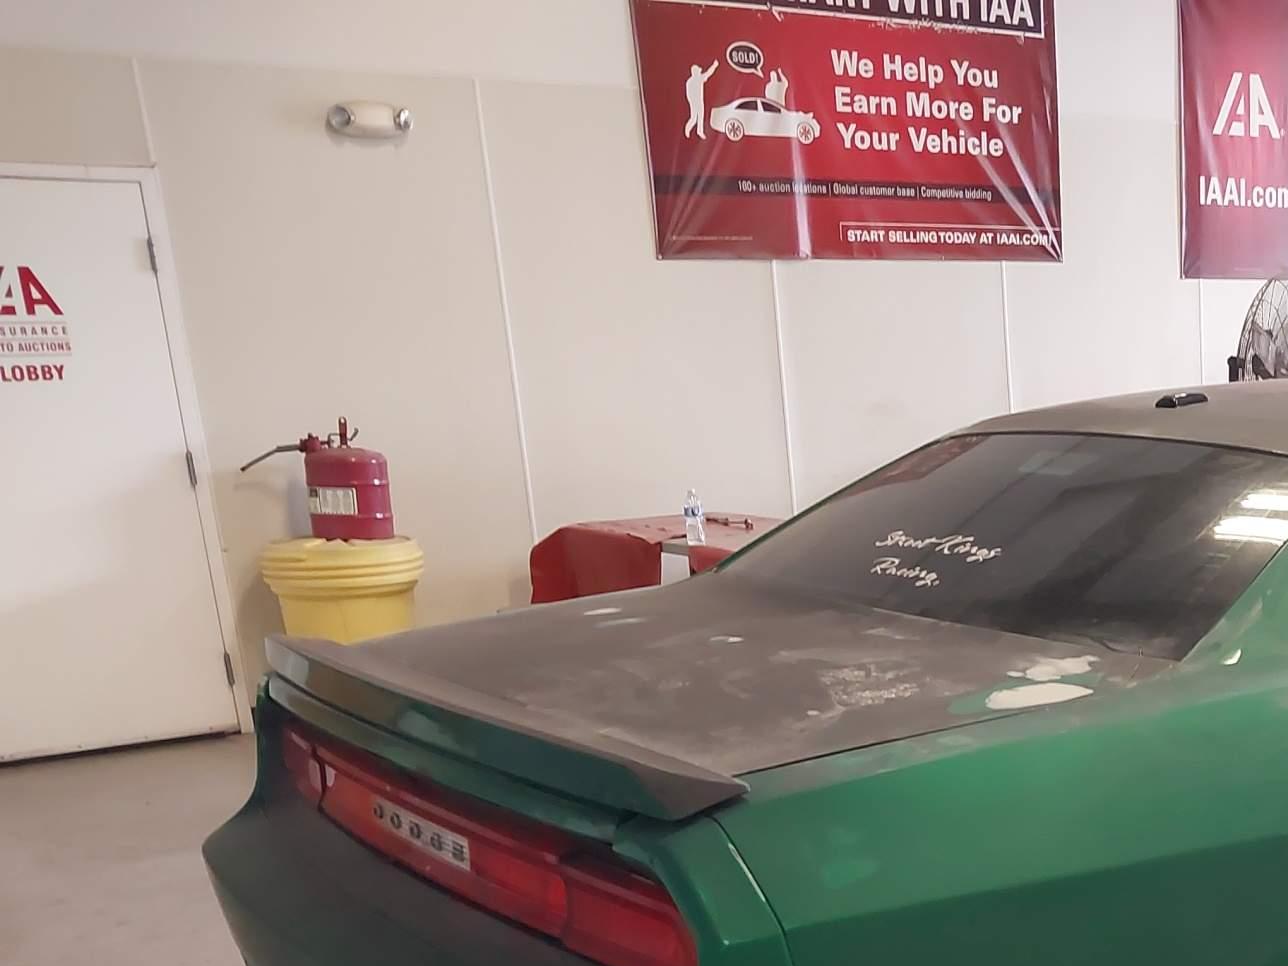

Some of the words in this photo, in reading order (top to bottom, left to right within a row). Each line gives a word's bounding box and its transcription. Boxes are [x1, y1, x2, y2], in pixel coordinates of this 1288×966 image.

[980, 0, 1035, 28] IAA
[732, 51, 759, 64] SOLD!
[831, 49, 874, 79] We
[883, 53, 944, 89] Help
[950, 59, 999, 89] You
[834, 86, 897, 116] Earn
[906, 91, 974, 121] More
[982, 97, 1022, 124] For
[836, 122, 900, 151] Your
[908, 126, 1004, 157] Vehicle
[759, 181, 791, 193] auction
[833, 182, 858, 196] Global
[860, 185, 895, 197] customer
[897, 186, 915, 197] base
[921, 186, 964, 199] Competitive
[965, 187, 992, 202] bidding
[847, 229, 885, 242] START
[889, 231, 937, 243] SELLING
[938, 231, 976, 244] TODAY
[980, 232, 994, 245] AT
[18, 341, 72, 353] AUCTIONS
[0, 364, 64, 382] LOBBY
